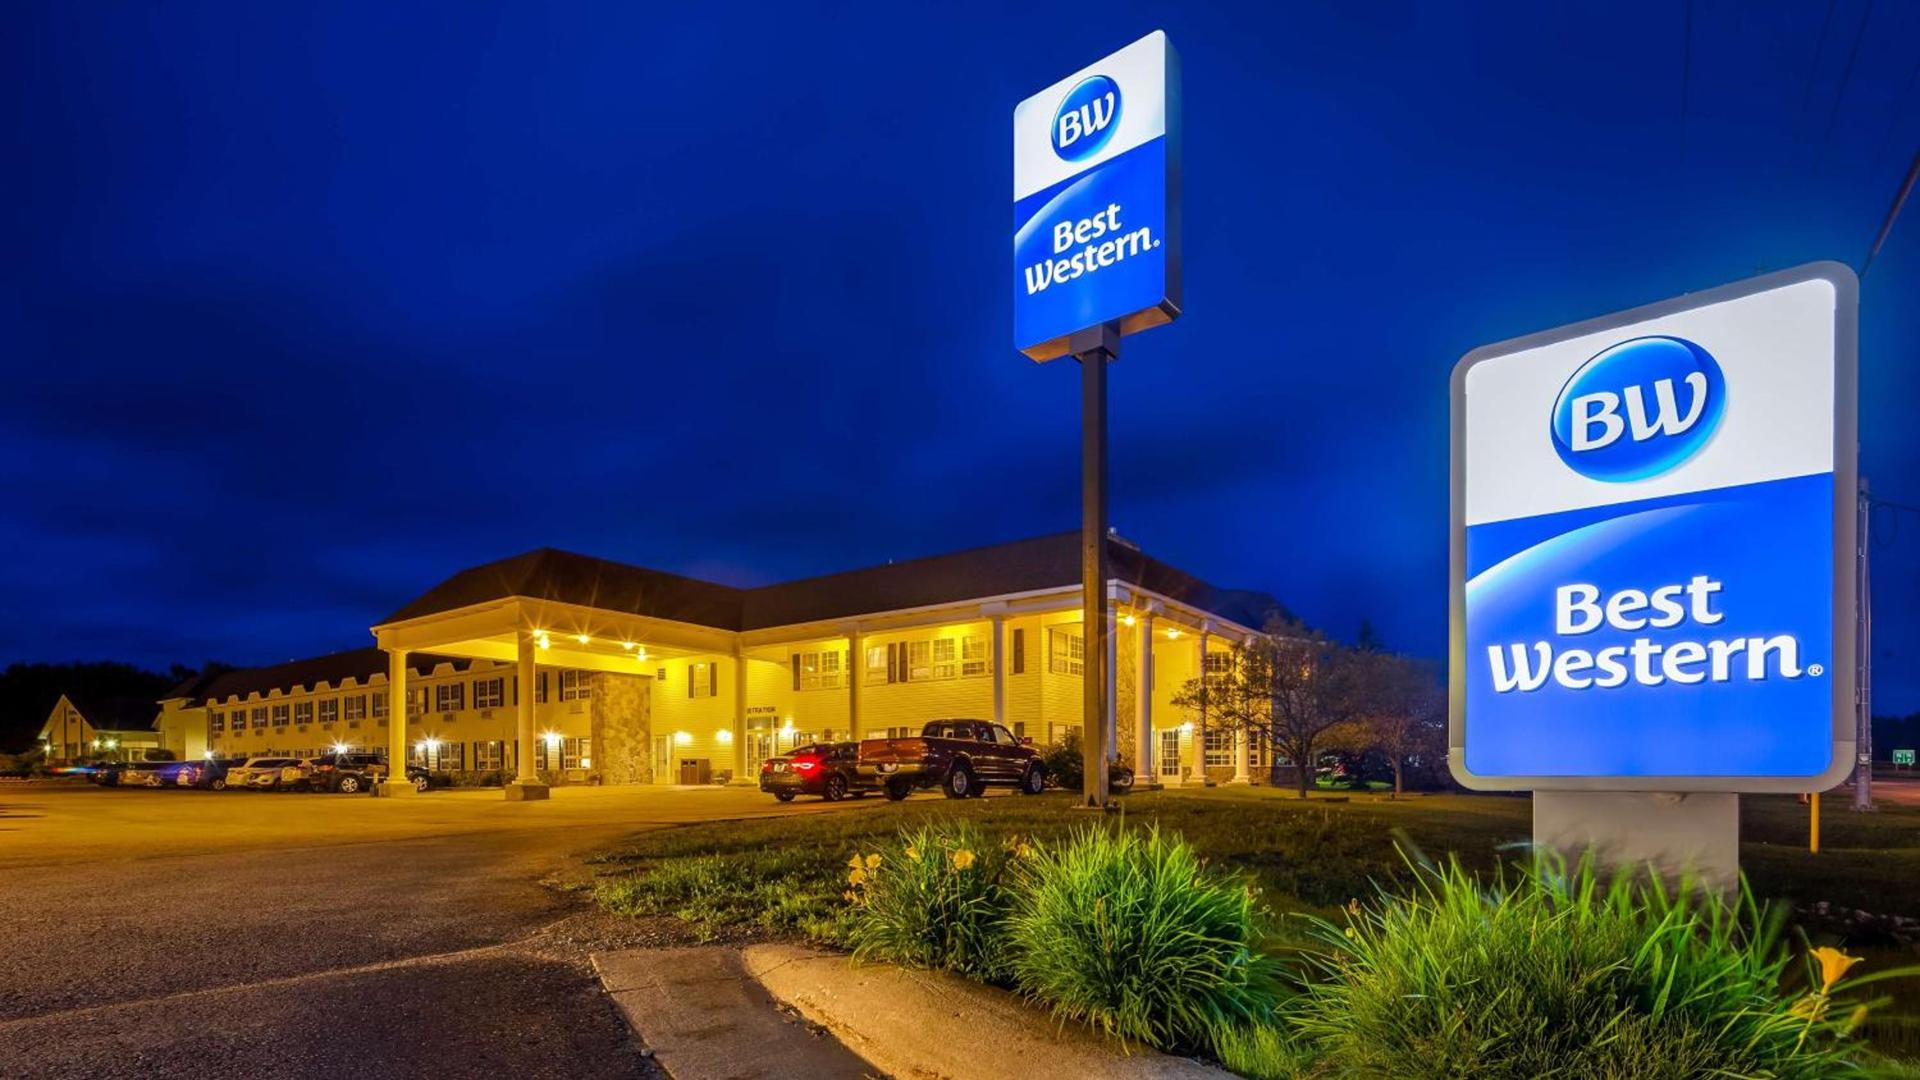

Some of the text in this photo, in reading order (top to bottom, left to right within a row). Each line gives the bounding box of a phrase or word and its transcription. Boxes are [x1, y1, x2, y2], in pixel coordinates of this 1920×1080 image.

[1058, 91, 1115, 149] BW
[1053, 202, 1121, 254] Best
[1571, 371, 1708, 452] BW
[1556, 575, 1723, 635] Best
